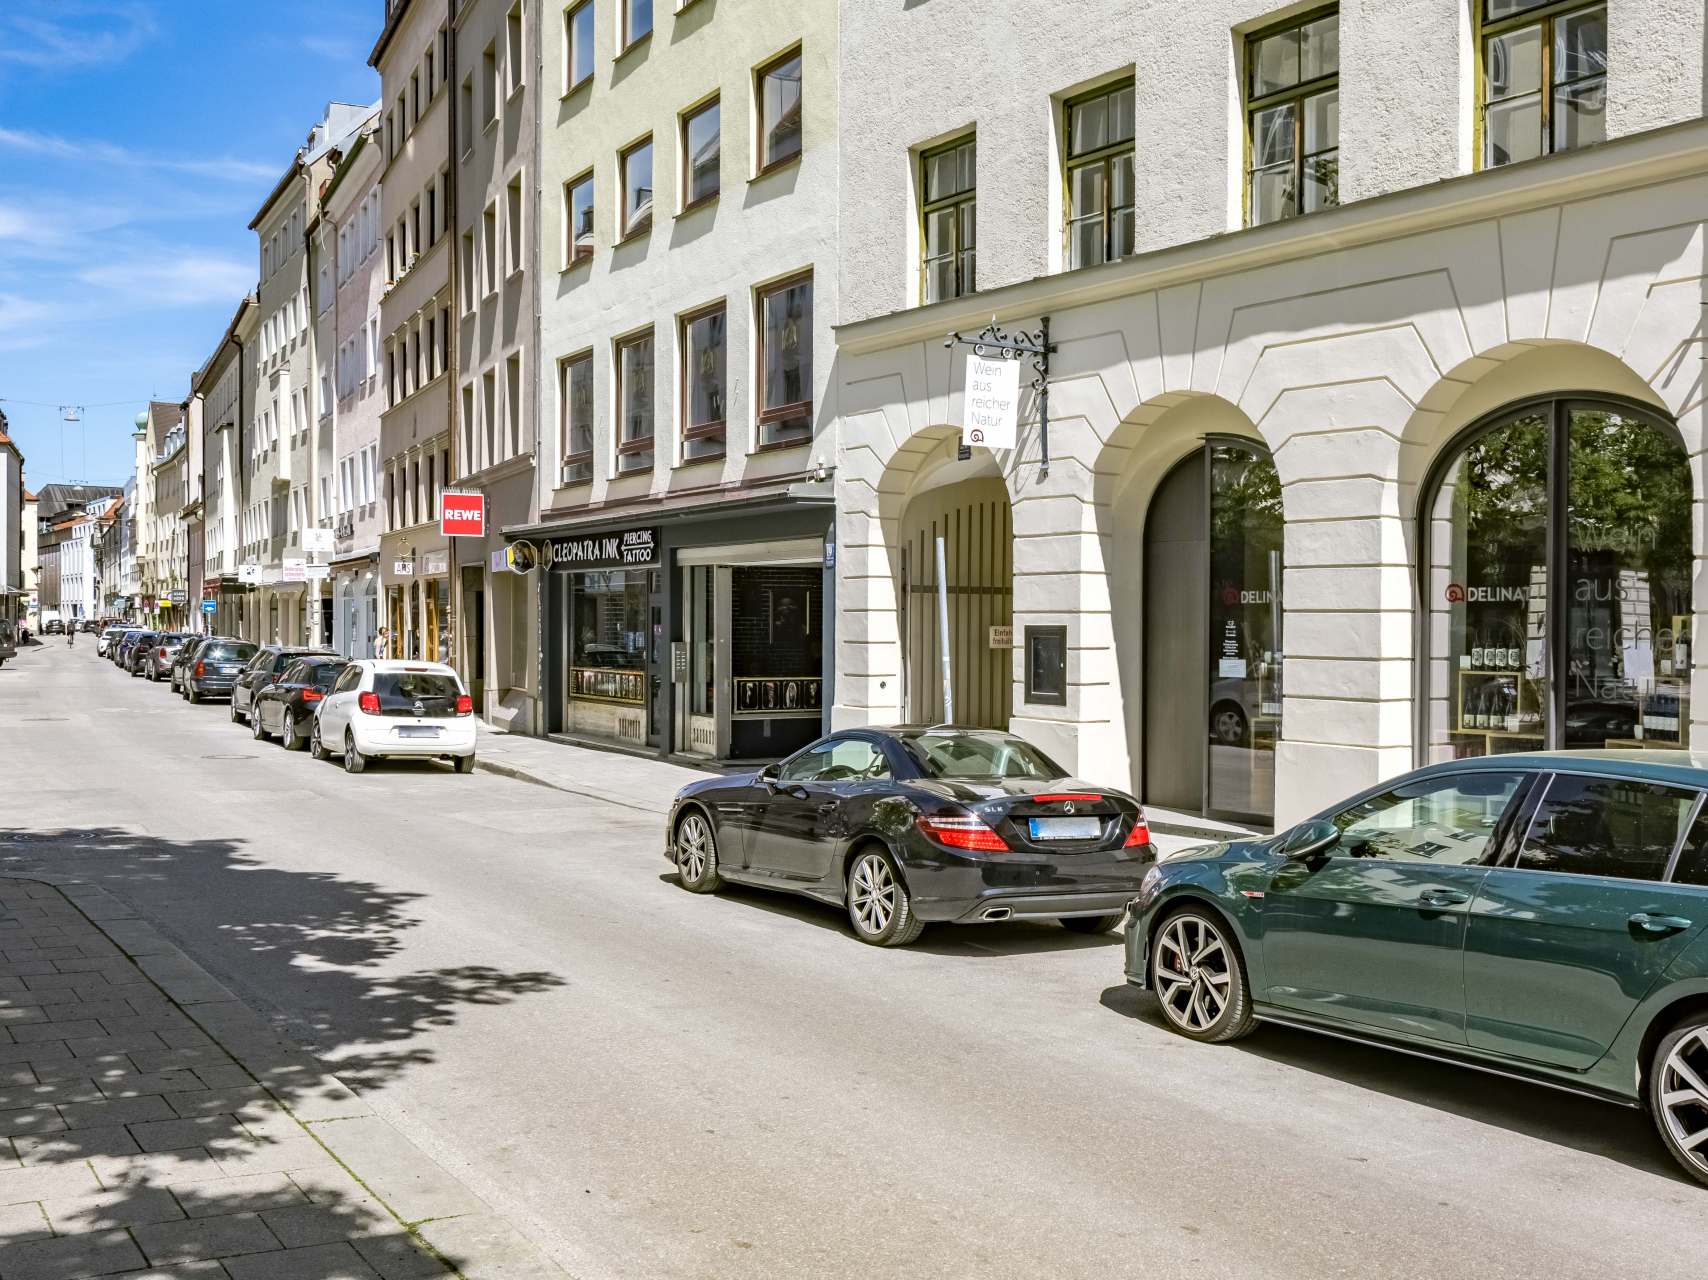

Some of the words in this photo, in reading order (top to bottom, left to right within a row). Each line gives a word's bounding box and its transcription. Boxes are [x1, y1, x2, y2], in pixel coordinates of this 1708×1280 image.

[973, 361, 1002, 377] Wein
[972, 380, 992, 392] aus
[971, 396, 1011, 411] reicher
[971, 412, 1003, 427] Natur
[445, 509, 482, 521] REWE
[623, 530, 652, 545] PIERCING
[1576, 523, 1656, 552] Wein
[553, 540, 600, 563] CLEOPATRA
[602, 538, 619, 560] INK
[623, 548, 652, 563] TATTOO
[1467, 587, 1532, 602] DELINAT
[1575, 578, 1629, 601] aus
[1576, 620, 1692, 652] reicher
[1576, 667, 1661, 702] Natur
